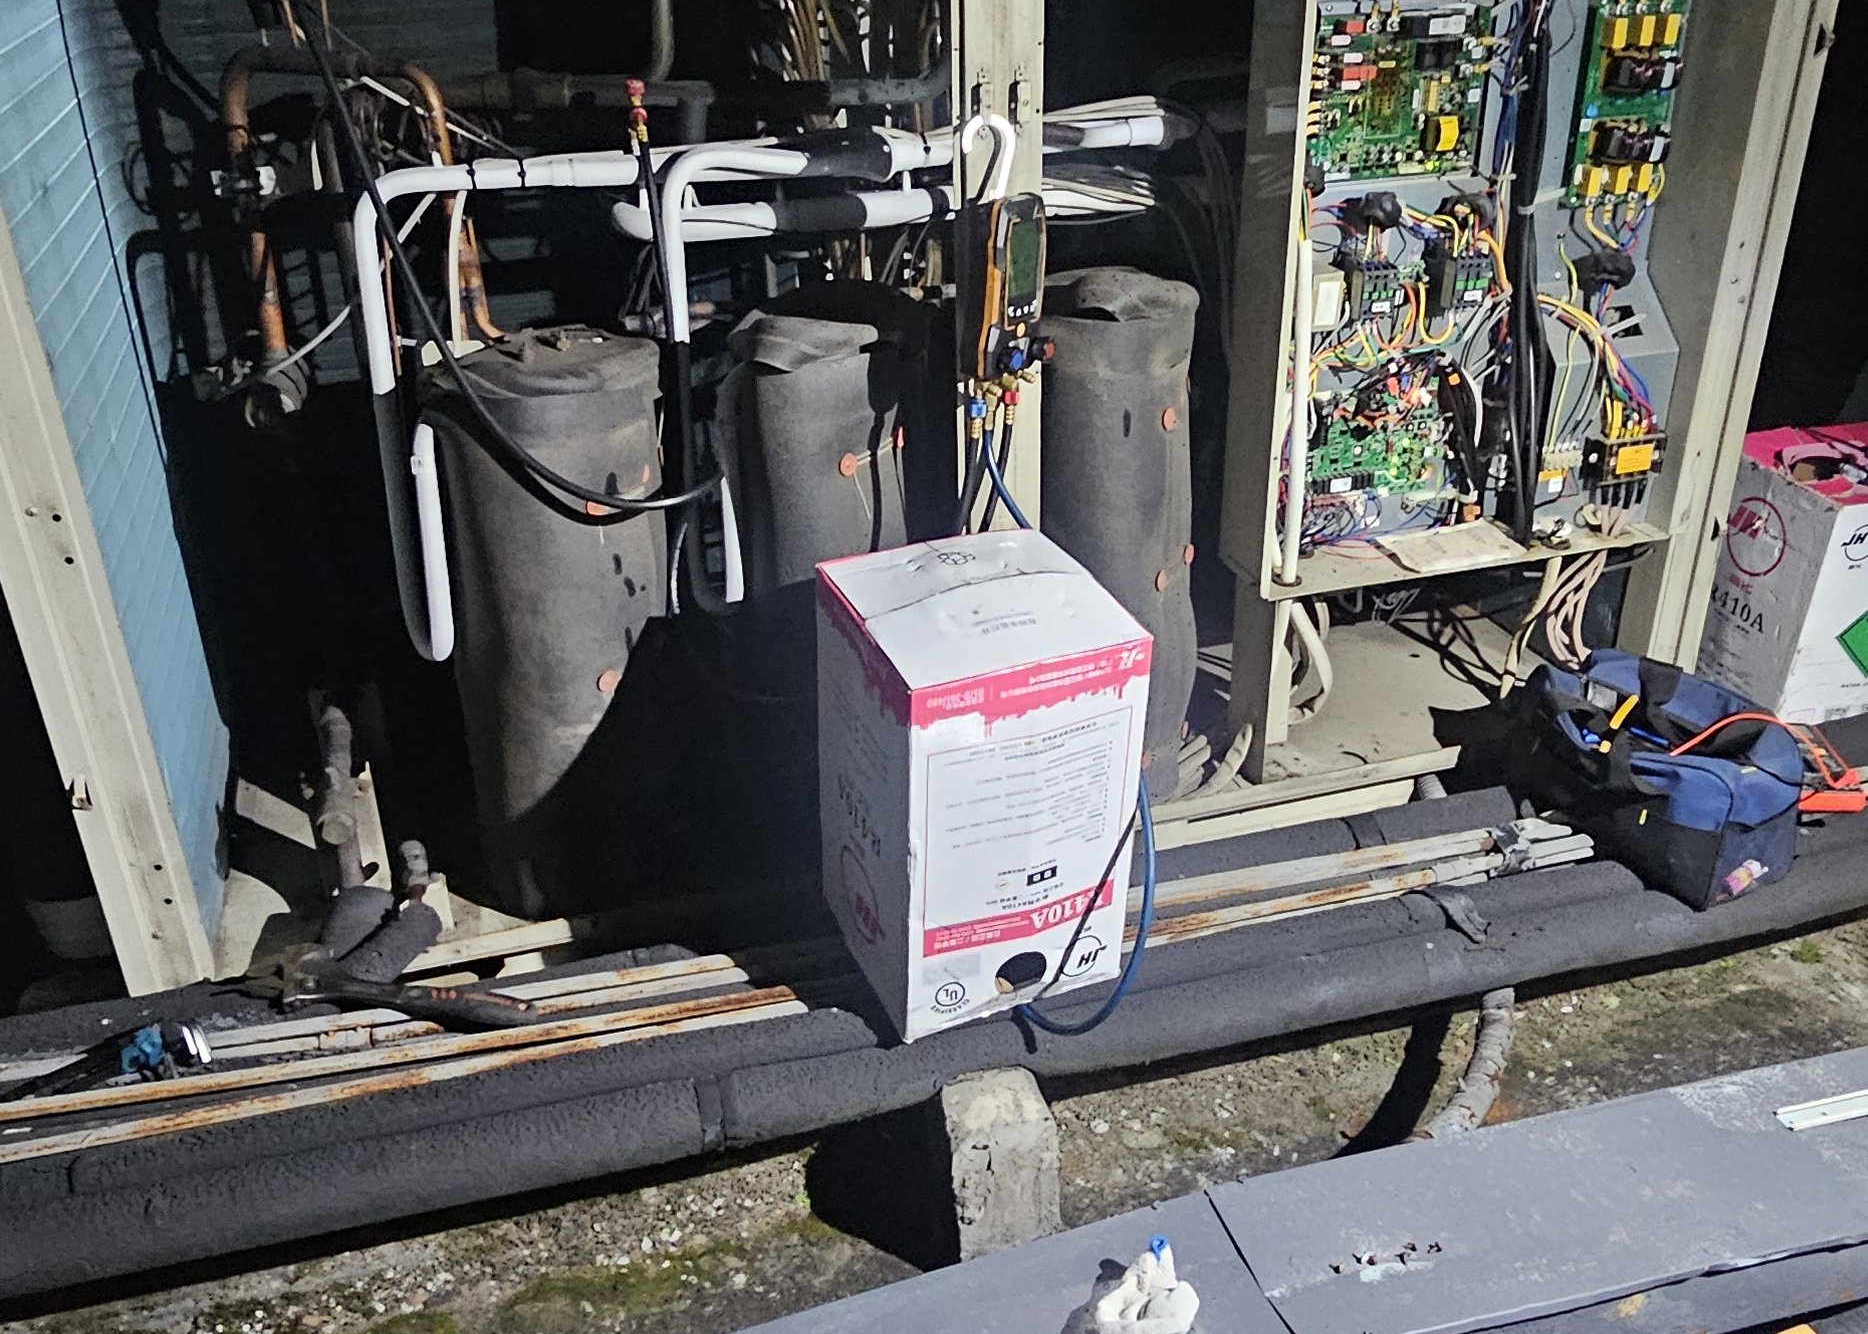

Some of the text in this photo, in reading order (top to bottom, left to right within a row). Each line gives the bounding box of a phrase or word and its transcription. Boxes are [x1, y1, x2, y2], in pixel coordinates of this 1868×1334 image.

[1030, 889, 1104, 929] 410A
[1076, 945, 1107, 969] JH
[943, 988, 958, 1002] UL
